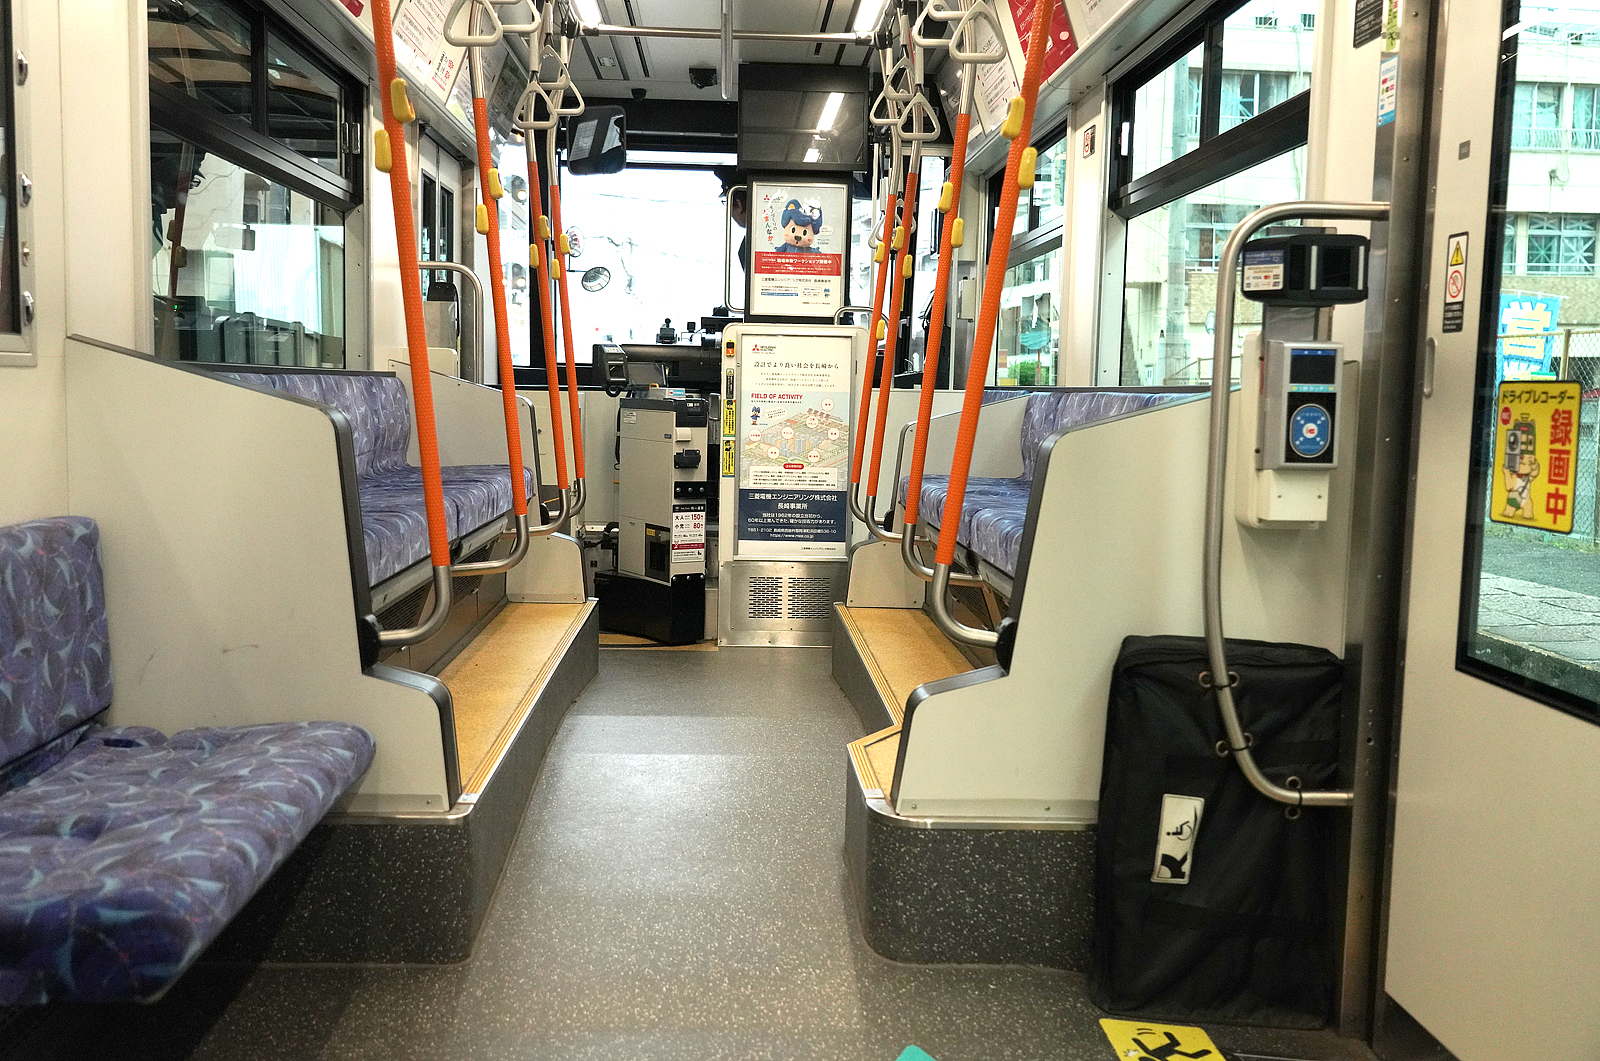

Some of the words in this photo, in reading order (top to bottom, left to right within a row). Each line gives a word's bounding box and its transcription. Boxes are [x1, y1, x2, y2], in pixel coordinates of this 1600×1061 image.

[753, 361, 839, 370] 設計でより良い社会を長崎から
[750, 392, 768, 400] FIELD
[1501, 389, 1576, 405] ドライブレコーダー
[1545, 407, 1574, 526] 録画中
[748, 492, 838, 502] 三菱電機エンジニアリング株式会社
[777, 502, 808, 510] 長崎事業所
